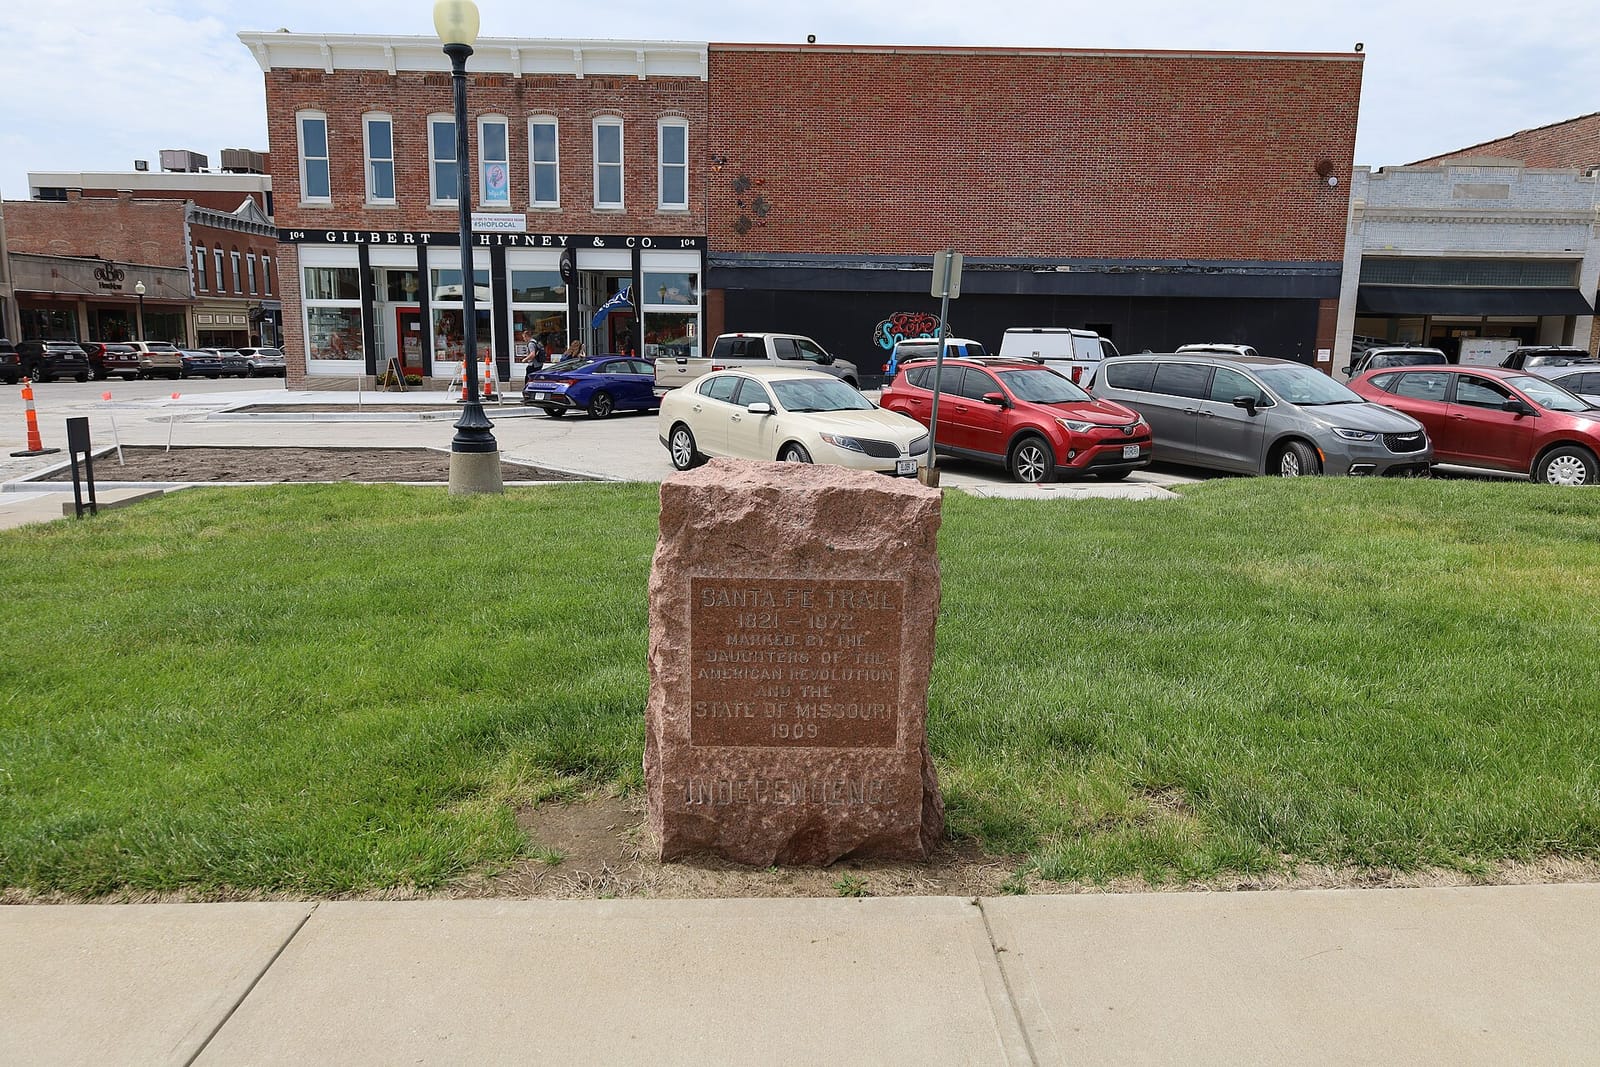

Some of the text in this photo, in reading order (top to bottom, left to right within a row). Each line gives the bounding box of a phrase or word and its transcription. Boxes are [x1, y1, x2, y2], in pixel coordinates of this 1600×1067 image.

[289, 231, 305, 240] 104
[325, 231, 657, 248] GILBERT HITNEY & CO.
[680, 239, 695, 248] 104
[701, 587, 896, 610] SANTA FE TRAIL
[738, 613, 779, 629] 1821
[807, 613, 857, 630] 1872
[725, 634, 867, 647] MARKED BY THE
[705, 651, 886, 665] DAUGHTERS OF THE
[699, 667, 893, 682] AMERICAN REVOLUTION
[755, 685, 833, 699] AND THE
[695, 701, 892, 720] STATE OF MISSOURI
[770, 723, 819, 739] 1909
[685, 778, 899, 805] INDEPENDENCE
